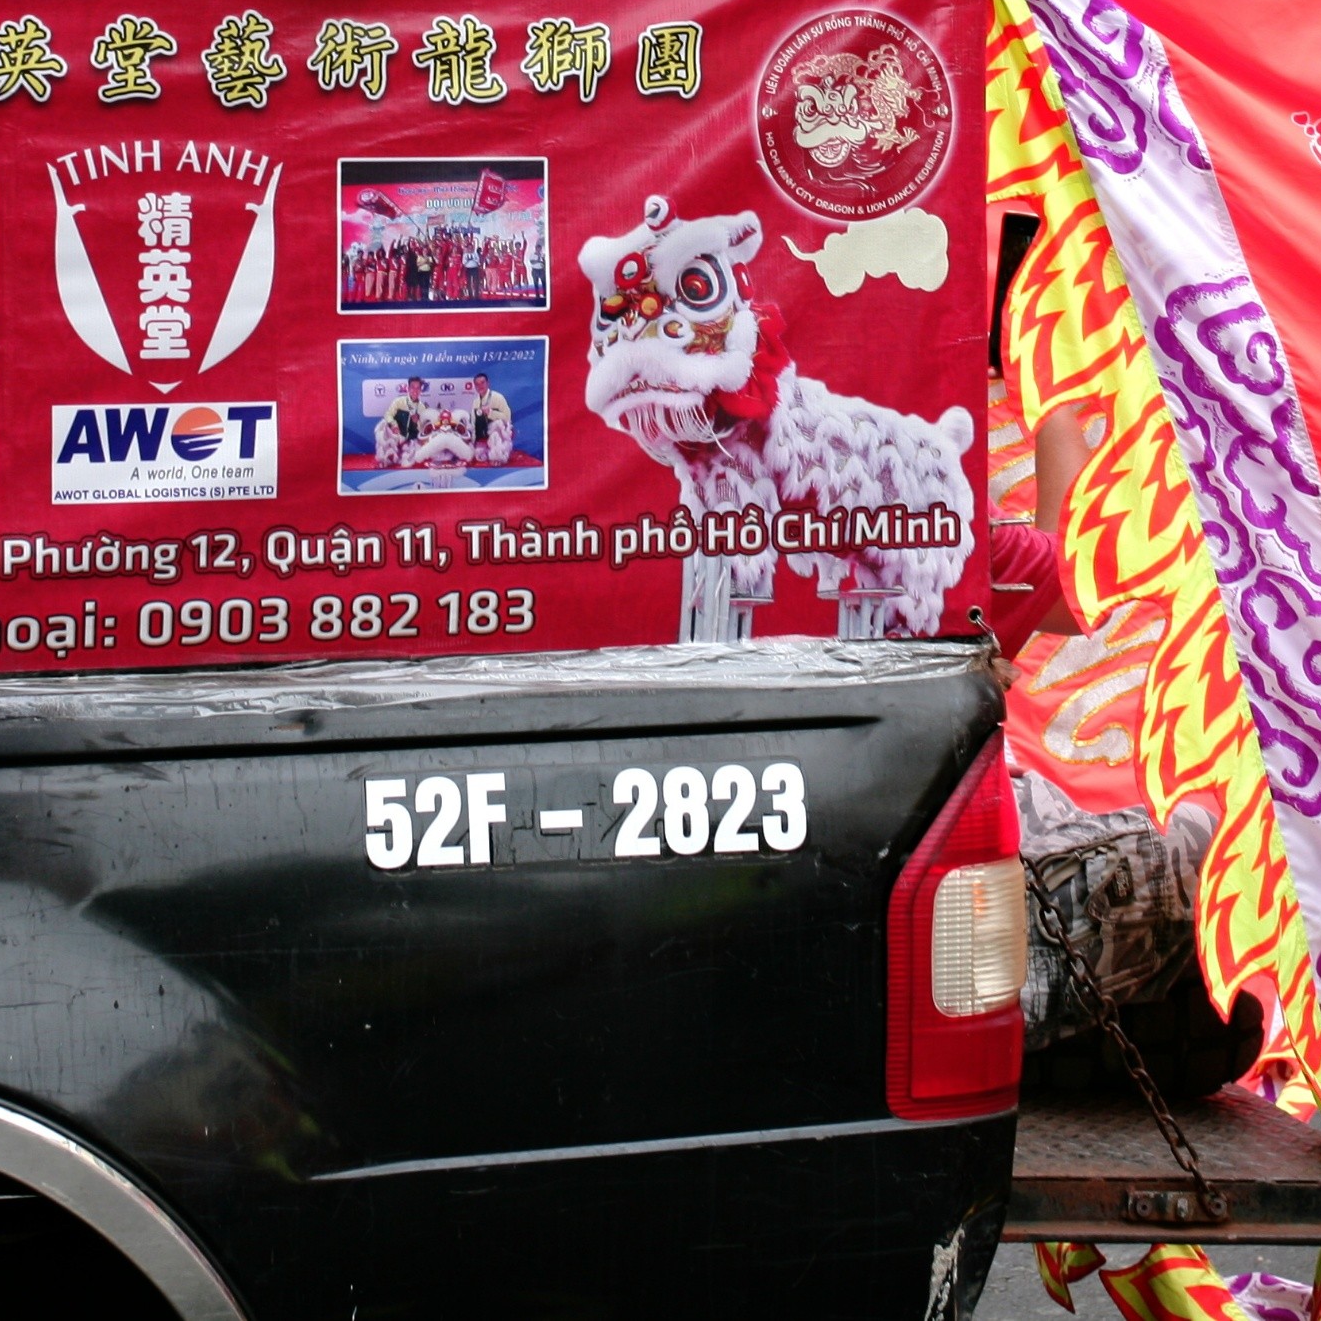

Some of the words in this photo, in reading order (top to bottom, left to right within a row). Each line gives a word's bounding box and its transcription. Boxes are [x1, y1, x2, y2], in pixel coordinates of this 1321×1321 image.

[56, 140, 162, 186] TINH
[176, 140, 269, 186] ANH
[815, 198, 855, 215] DRAGON
[138, 192, 192, 360] 精英堂
[421, 353, 433, 362] 10
[54, 490, 89, 501] AWOT
[92, 488, 141, 500] GLOBAL
[145, 486, 207, 499] LOGISTICS
[210, 486, 226, 498] (S)
[228, 485, 250, 497] PTE
[253, 484, 274, 496] LTD
[130, 467, 140, 480] A
[191, 465, 218, 479] One
[222, 465, 254, 479] team
[3, 534, 178, 578] Phường
[192, 534, 251, 574] 12,
[267, 529, 382, 574] Quận
[395, 527, 449, 567] 11,
[462, 521, 599, 560] Thành
[614, 511, 696, 566] phố
[708, 508, 764, 551] Hồ
[777, 513, 841, 549] Chí
[855, 508, 961, 545] Minh
[139, 598, 290, 646] 0903
[310, 593, 418, 641] 882
[438, 587, 536, 635] 183
[365, 772, 506, 869] 52F
[612, 762, 808, 858] 2823
